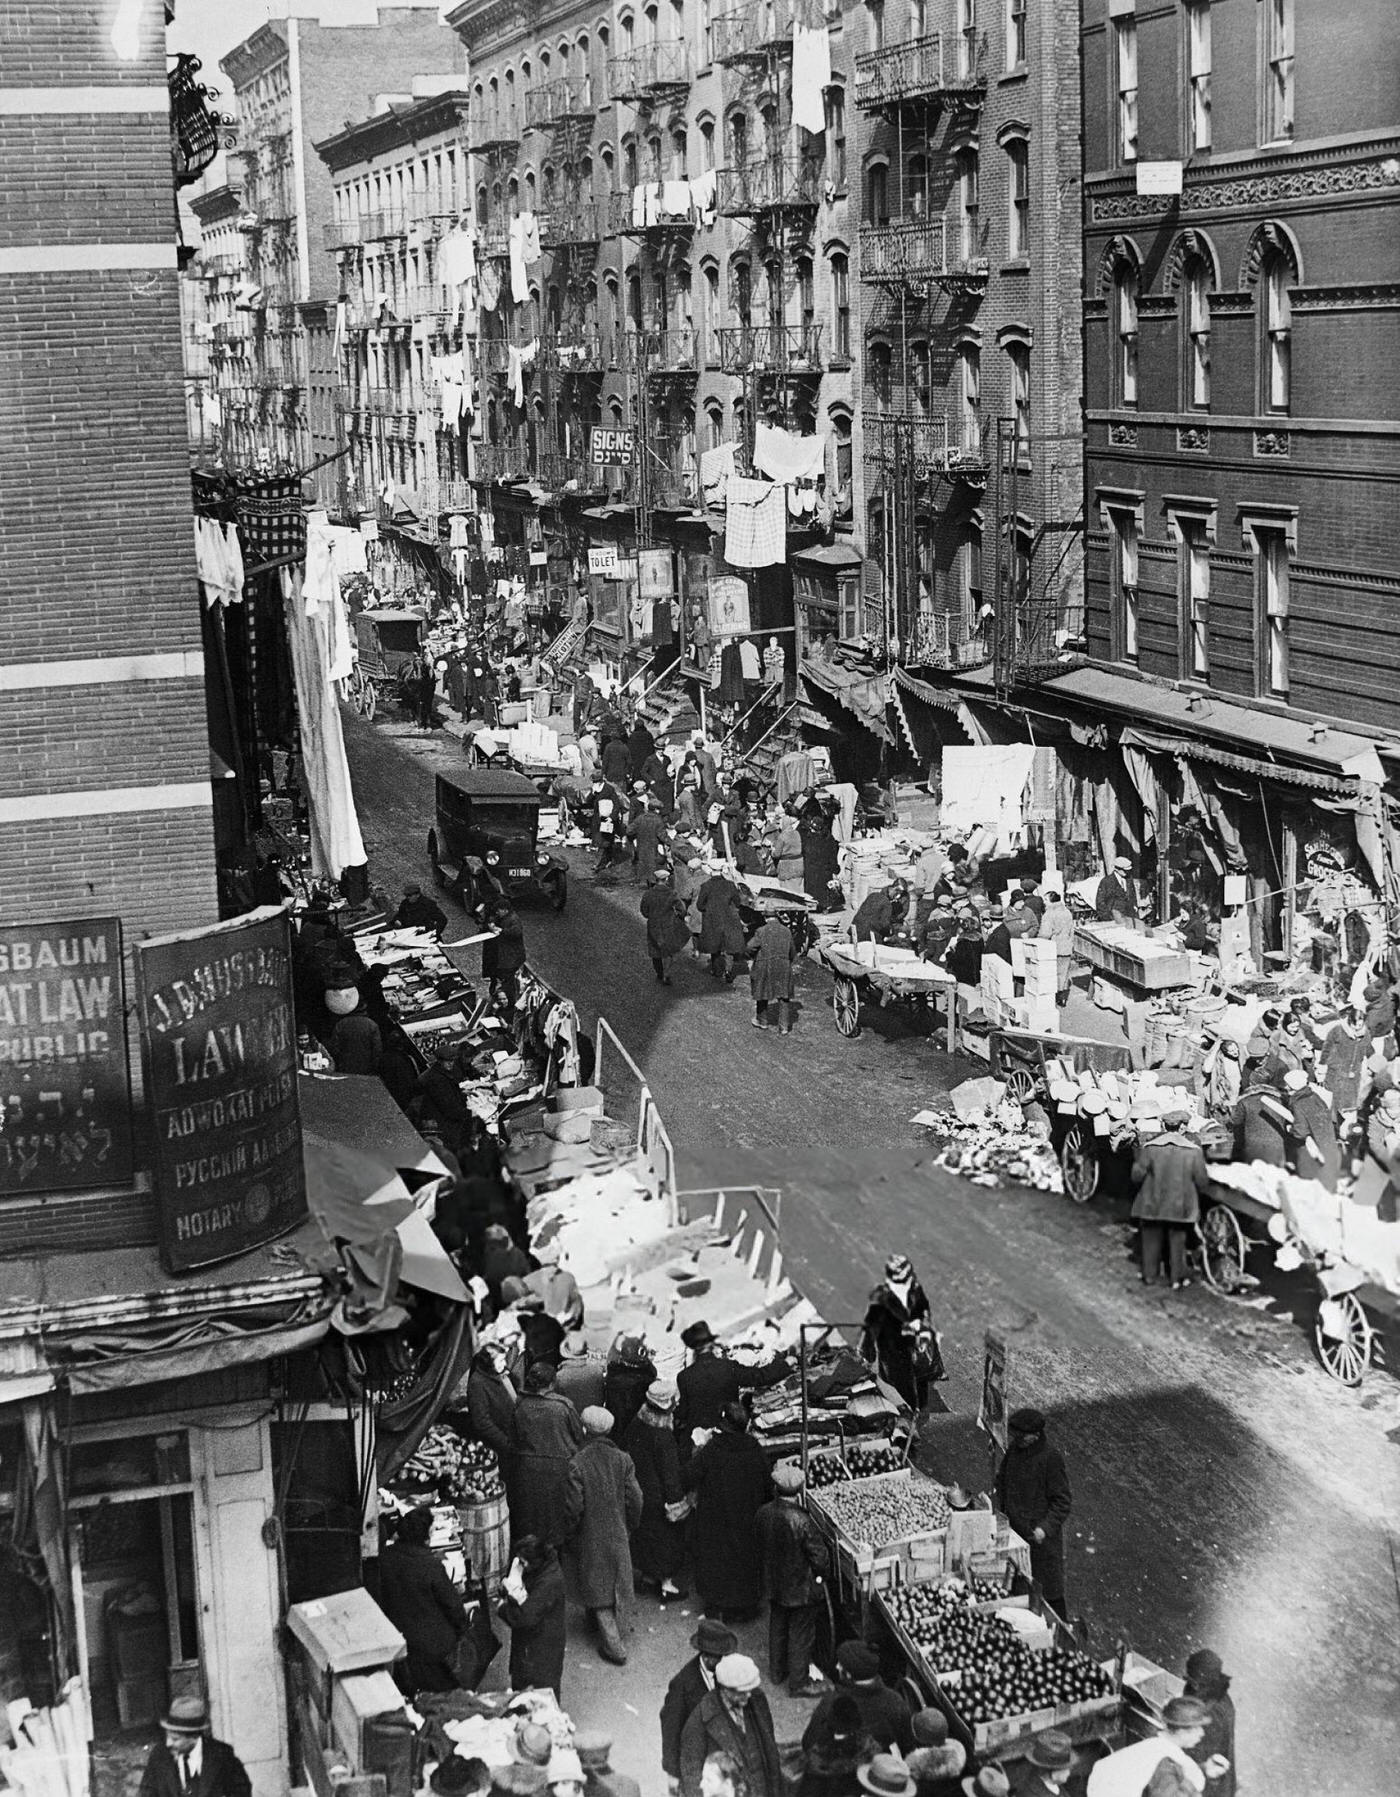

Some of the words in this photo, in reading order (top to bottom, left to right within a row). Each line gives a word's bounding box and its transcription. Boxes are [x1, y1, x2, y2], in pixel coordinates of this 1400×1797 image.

[593, 430, 633, 452] SIGNS
[590, 557, 600, 567] TO
[601, 556, 616, 567] LET
[0, 982, 32, 1026] AT
[39, 976, 112, 1023] LAW
[176, 1200, 242, 1241] NOTARY
